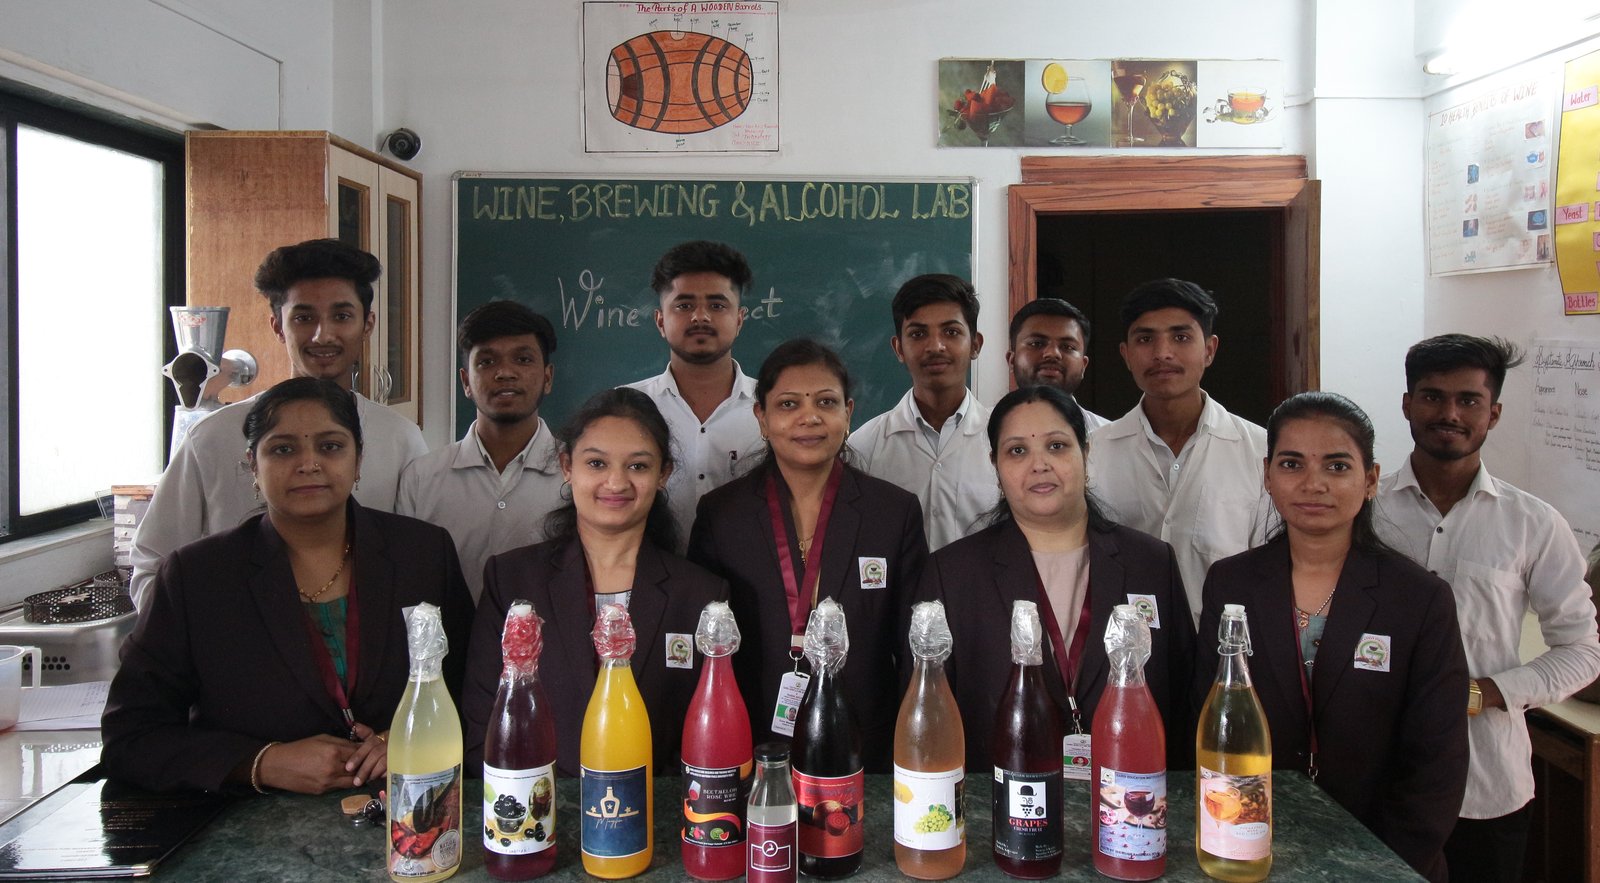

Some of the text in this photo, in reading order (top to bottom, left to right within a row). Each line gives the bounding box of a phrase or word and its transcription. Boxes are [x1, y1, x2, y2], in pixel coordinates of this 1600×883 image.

[636, 1, 761, 14] The Parts of A WOODEN Barrels
[1513, 81, 1538, 101] WINE
[1570, 91, 1591, 106] Water
[567, 183, 719, 221] BREWING
[731, 181, 756, 227] &
[758, 183, 901, 221] ALCOHOL
[911, 184, 970, 219] LAB
[1562, 206, 1583, 219] Yeast
[557, 268, 642, 331] Wine
[1567, 295, 1596, 309] Bottles
[1008, 817, 1048, 828] GRAPES
